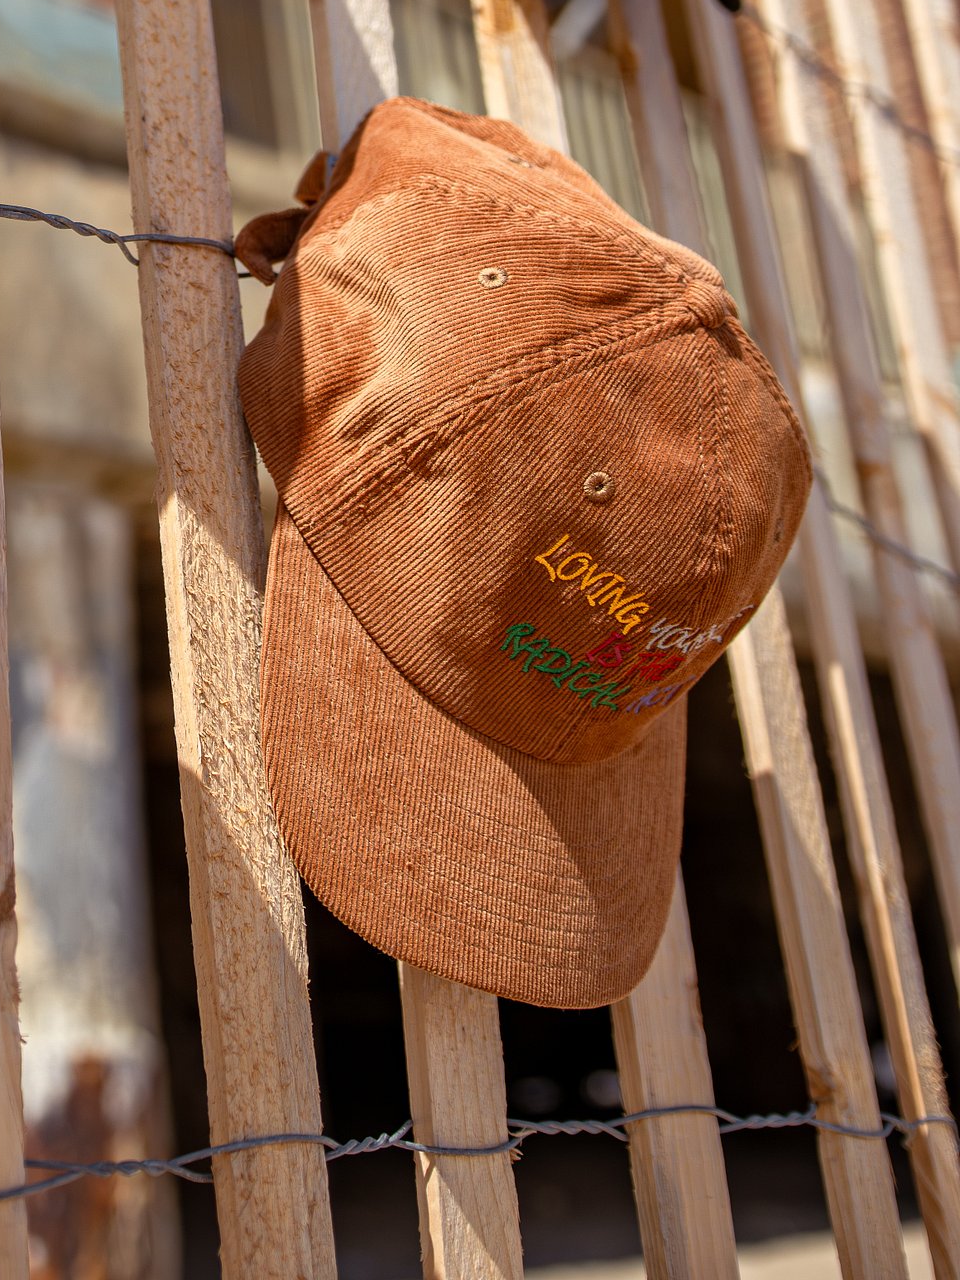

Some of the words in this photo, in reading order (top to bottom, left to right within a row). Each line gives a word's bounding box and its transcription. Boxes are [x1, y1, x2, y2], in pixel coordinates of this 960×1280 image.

[535, 533, 650, 635] LOVING
[500, 623, 631, 710] RADICAL
[586, 631, 632, 668] IS
